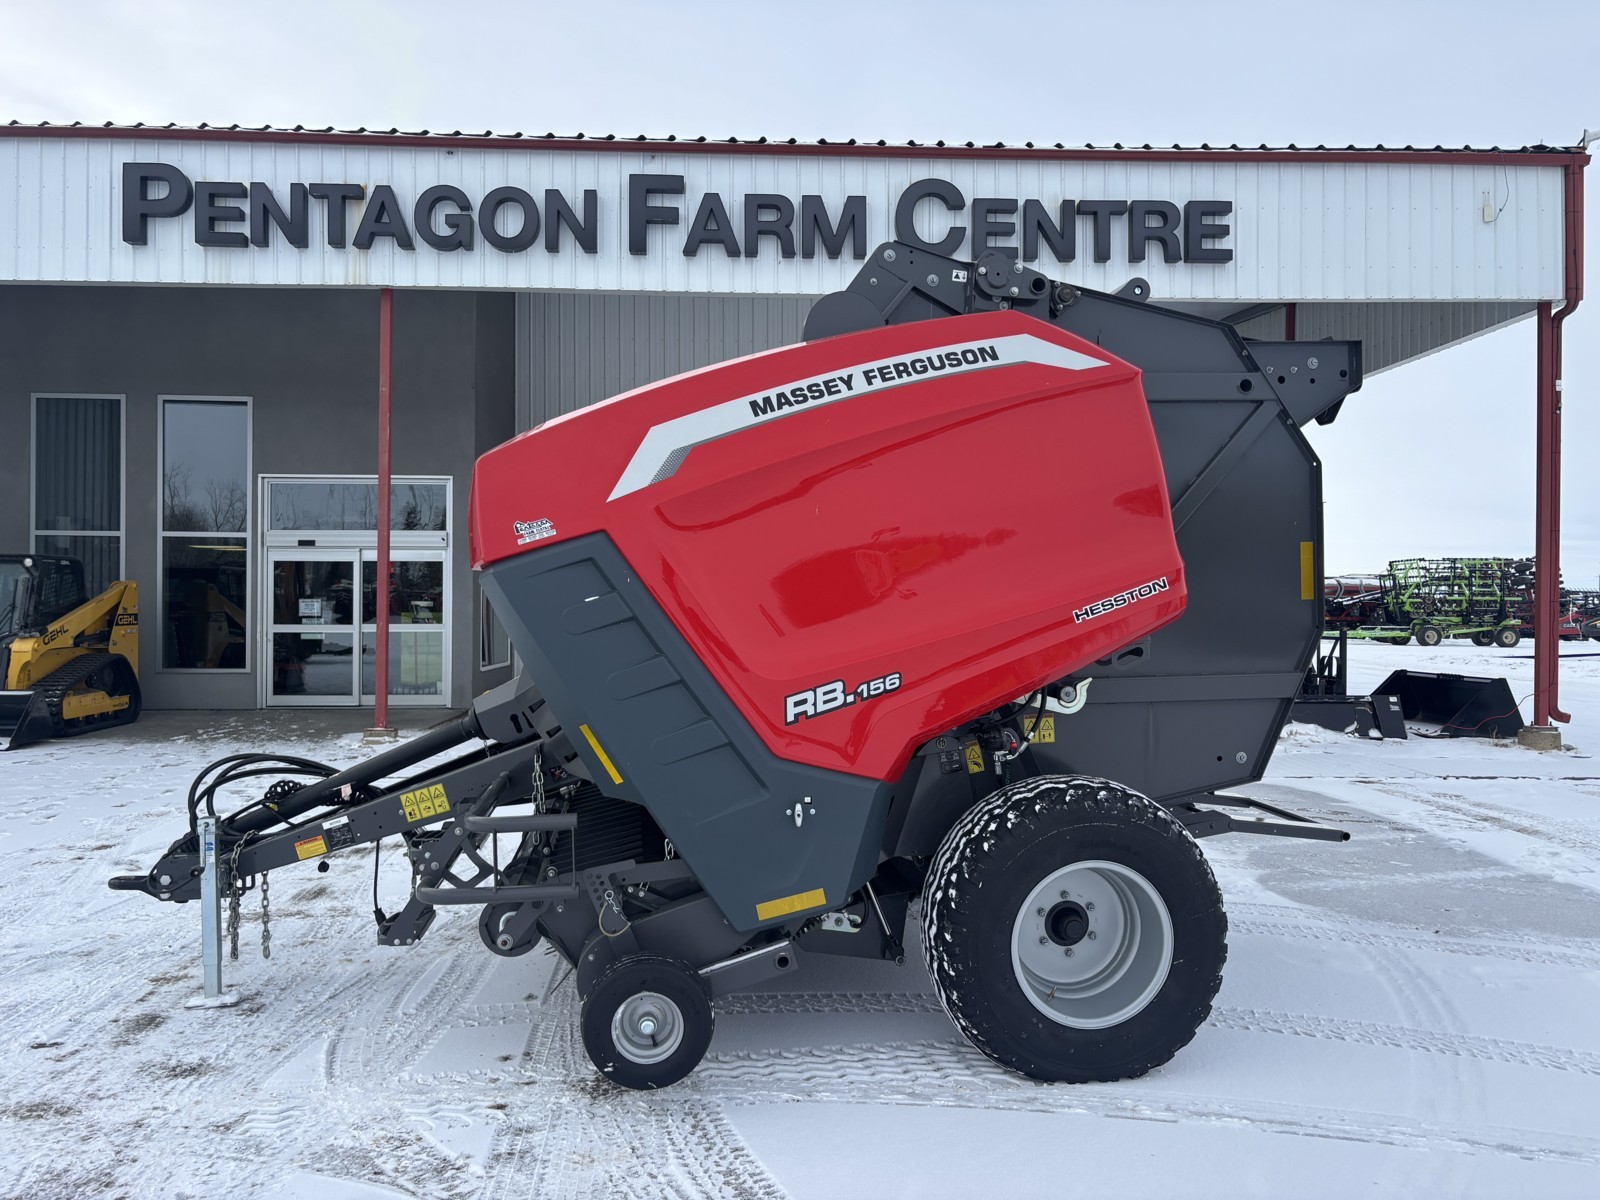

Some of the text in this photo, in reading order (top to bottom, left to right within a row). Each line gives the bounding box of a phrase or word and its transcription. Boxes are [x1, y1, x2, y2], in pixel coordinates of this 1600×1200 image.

[121, 161, 1233, 265] PENTAGON FARM CENTRE
[748, 344, 1001, 418] MASSEY FERGUSON
[118, 615, 138, 625] GEHL
[1073, 577, 1169, 623] HESSTON
[42, 624, 69, 646] GEHL
[784, 671, 902, 726] RB.156
